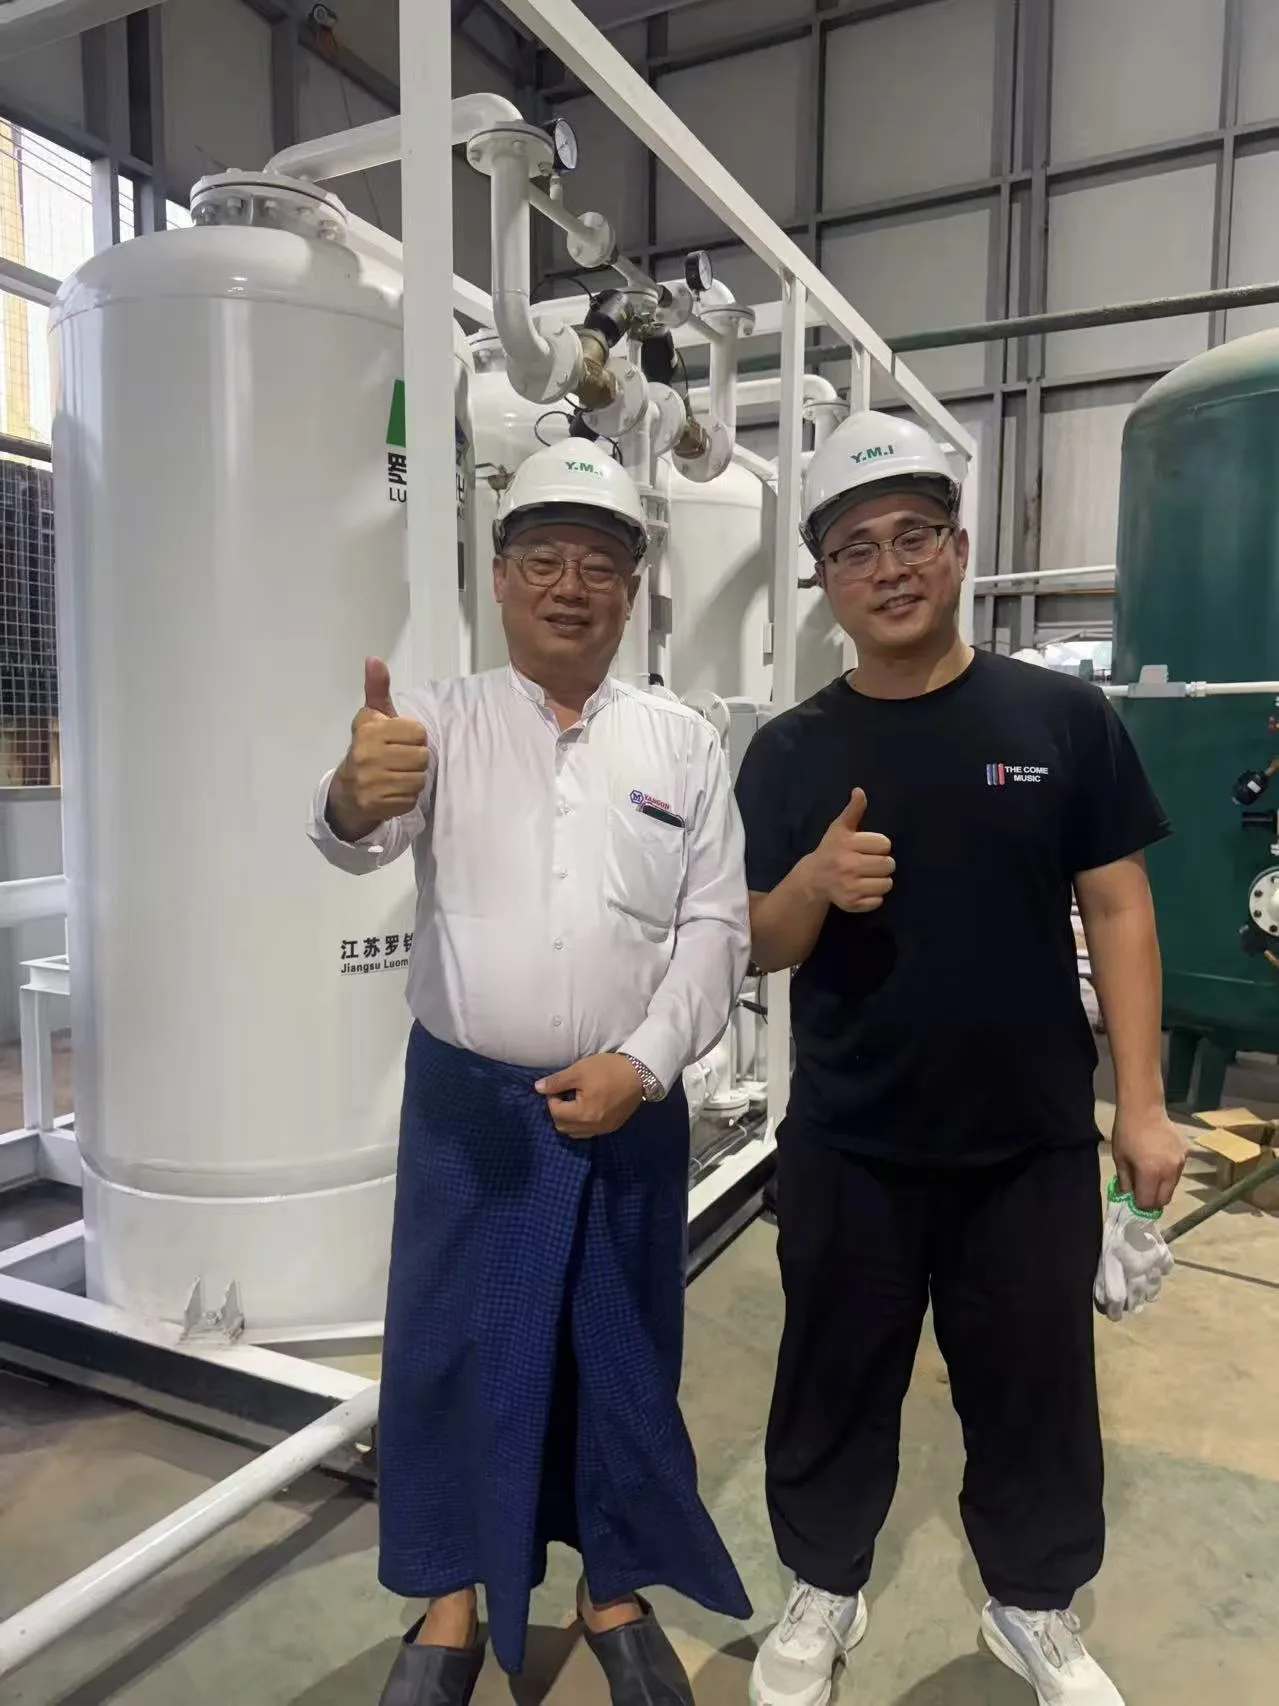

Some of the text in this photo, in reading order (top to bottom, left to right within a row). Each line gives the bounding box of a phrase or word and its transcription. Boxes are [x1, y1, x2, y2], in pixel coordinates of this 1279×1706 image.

[850, 445, 894, 463] Y.M.I
[1023, 766, 1049, 775] COME
[1013, 774, 1041, 782] MUSIC
[341, 962, 381, 973] Jiangsu
